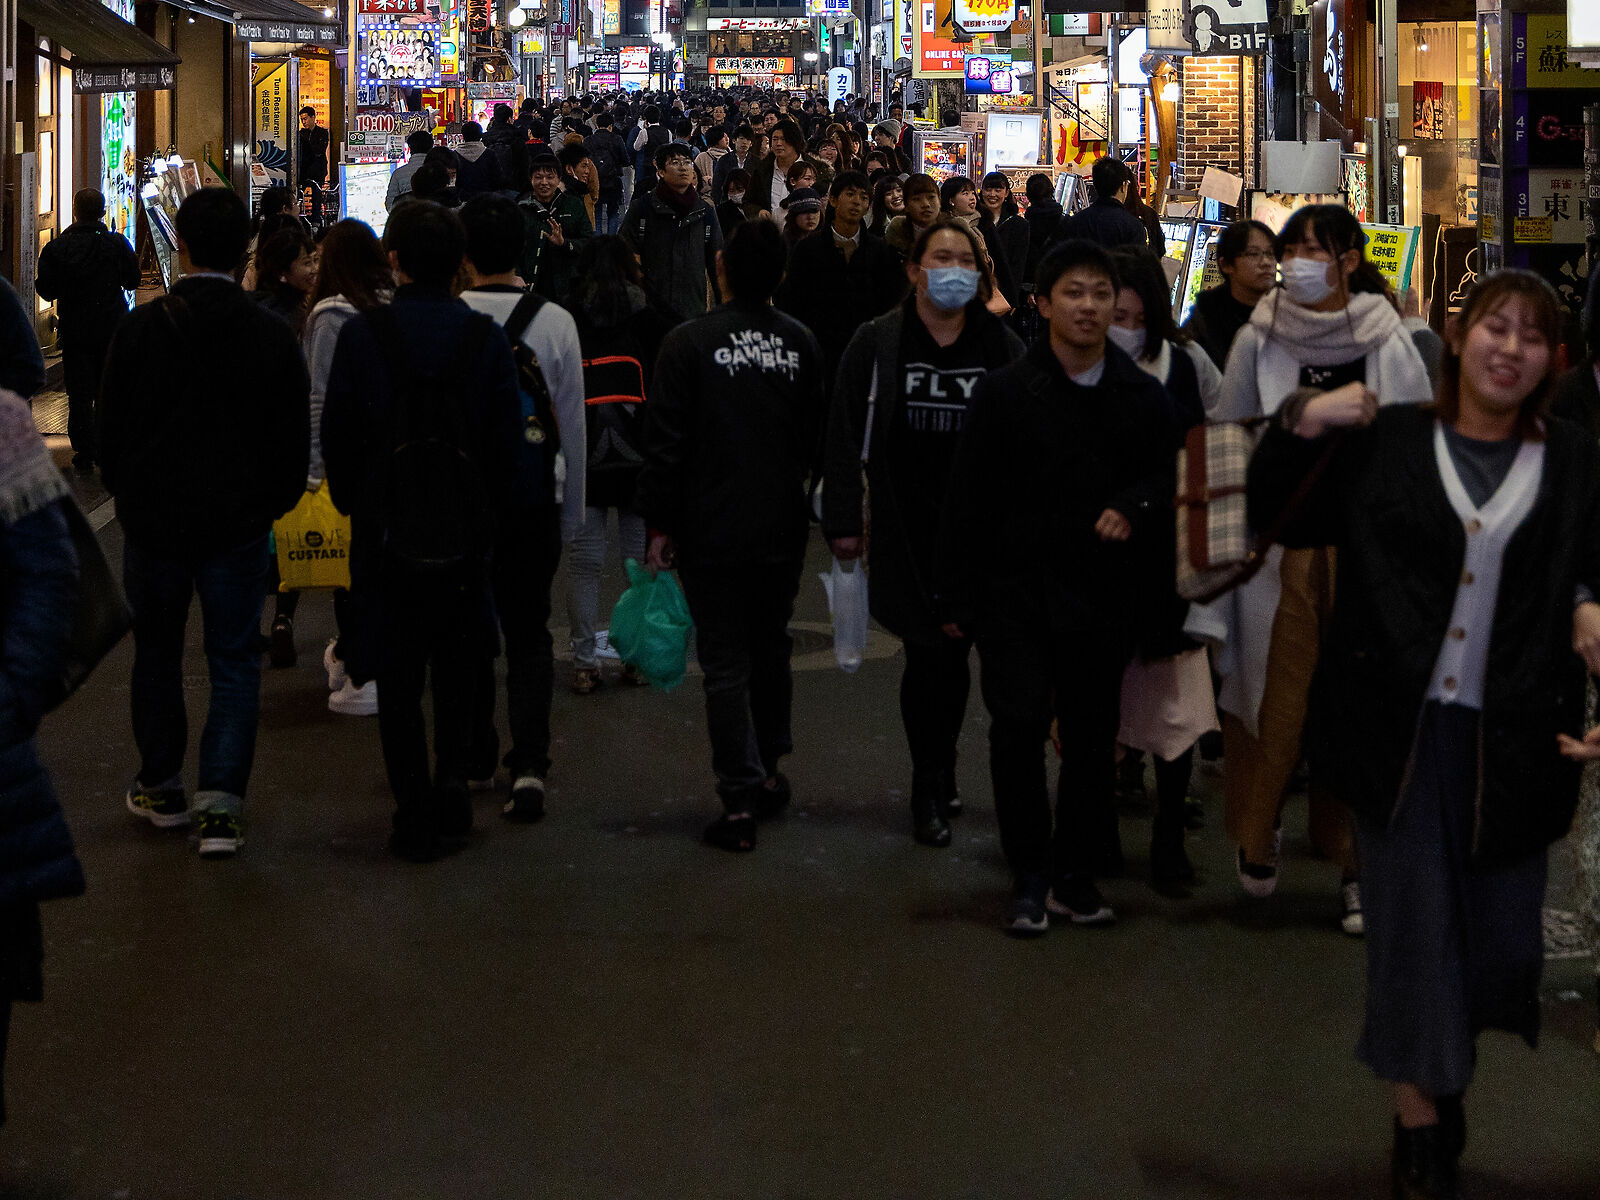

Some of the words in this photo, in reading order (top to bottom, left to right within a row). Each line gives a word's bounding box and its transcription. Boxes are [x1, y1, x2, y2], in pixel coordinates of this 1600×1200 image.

[719, 18, 756, 30] コーヒー
[1228, 31, 1267, 50] B1F
[925, 50, 949, 59] ONLINE
[622, 59, 648, 70] ゲーム
[714, 58, 780, 70] 無料案内所
[356, 114, 395, 132] 19:00
[394, 113, 426, 133] オープン
[713, 345, 800, 370] GAMBLE
[905, 371, 979, 399] FLY
